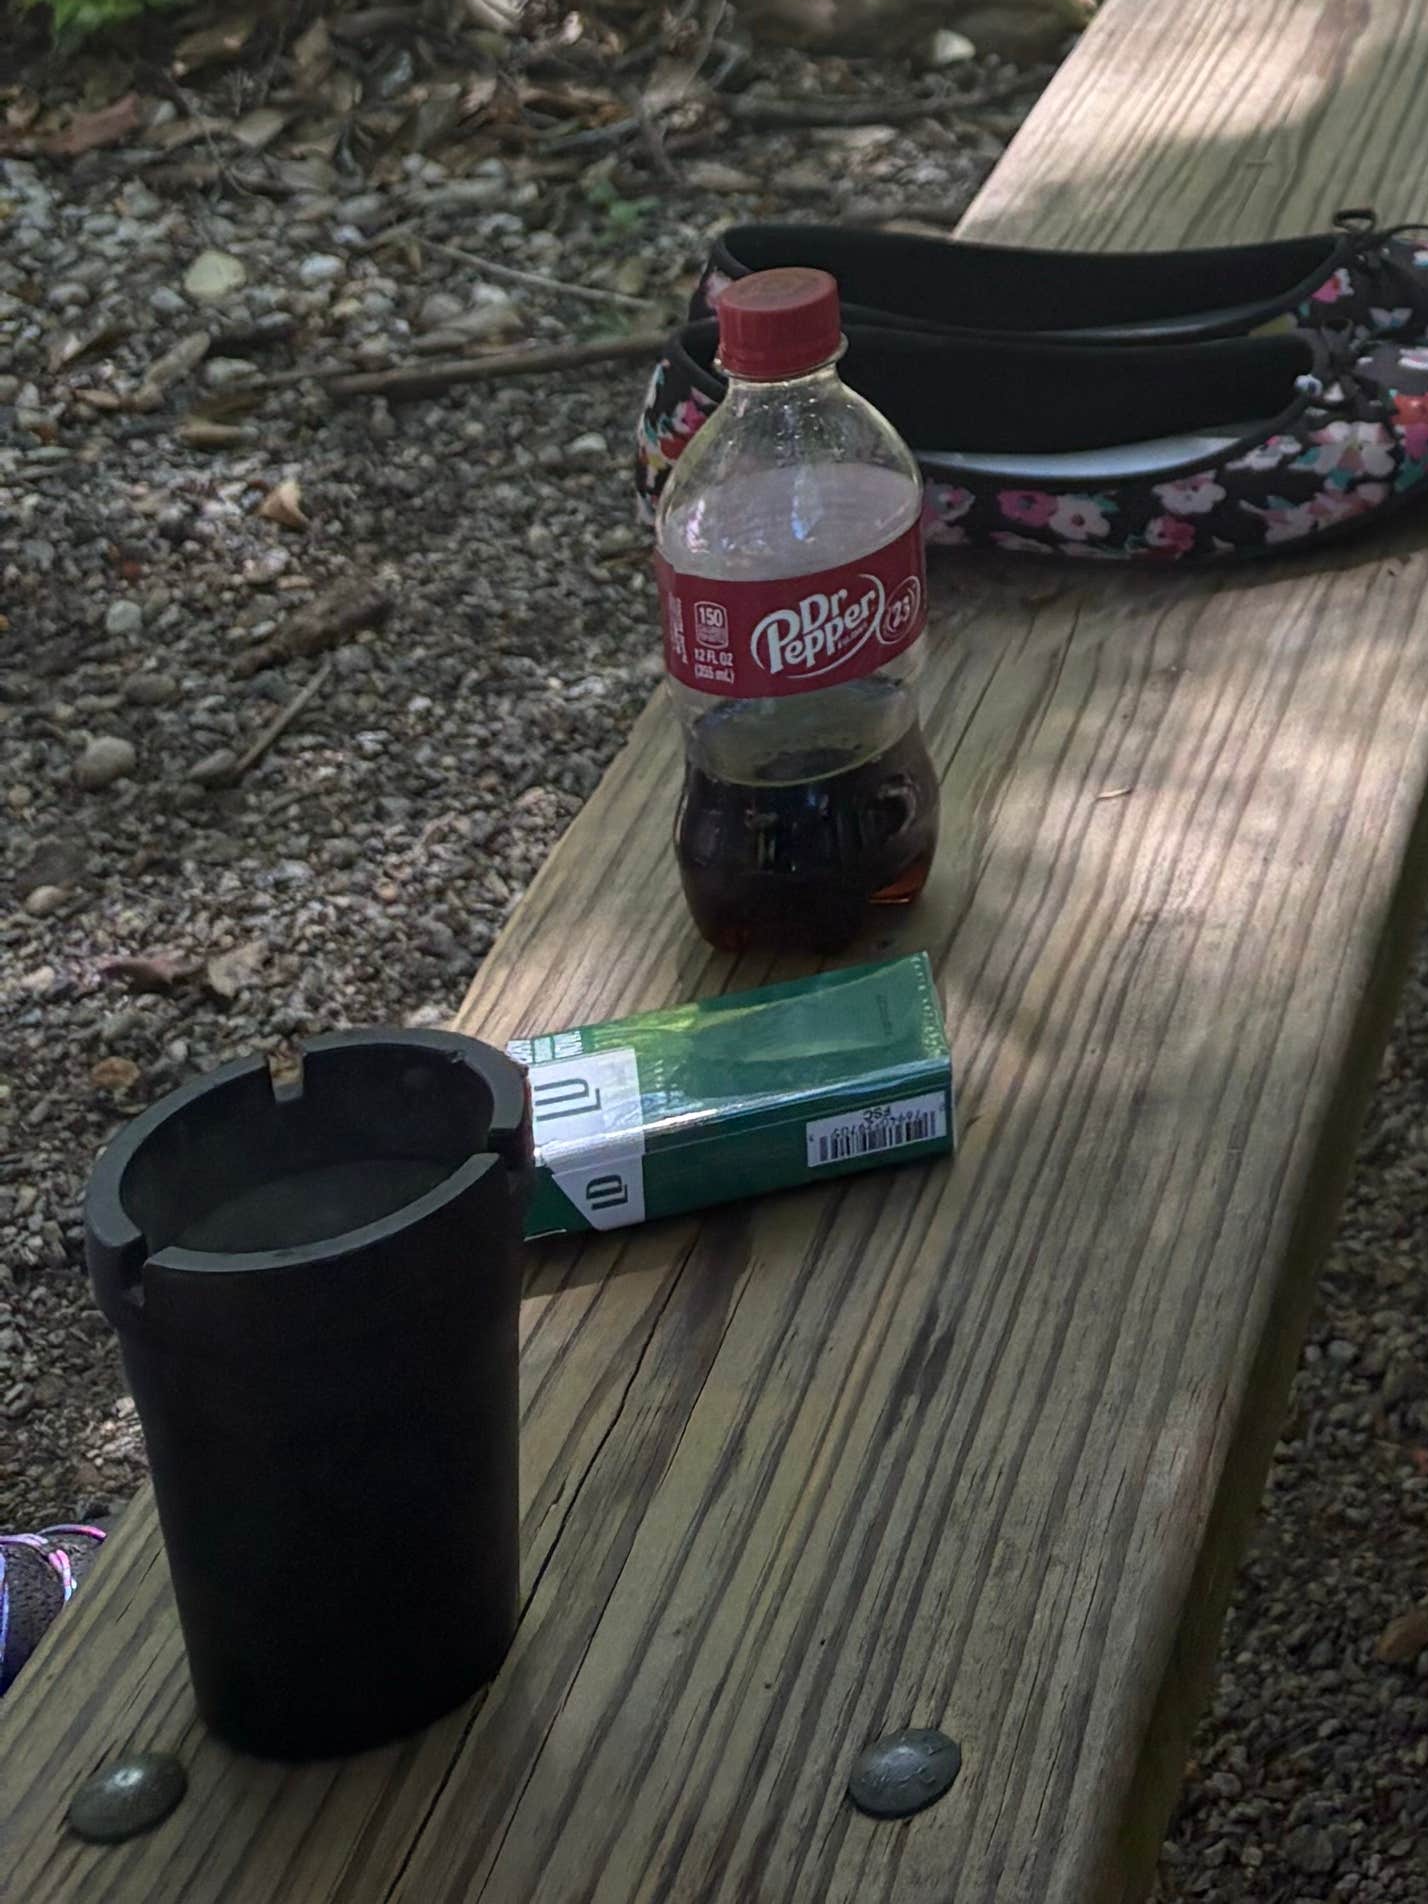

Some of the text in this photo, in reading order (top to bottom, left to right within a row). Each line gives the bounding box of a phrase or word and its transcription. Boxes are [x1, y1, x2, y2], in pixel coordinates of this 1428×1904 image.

[698, 605, 724, 628] 150
[751, 590, 876, 674] Pepper
[799, 588, 848, 635] Dr
